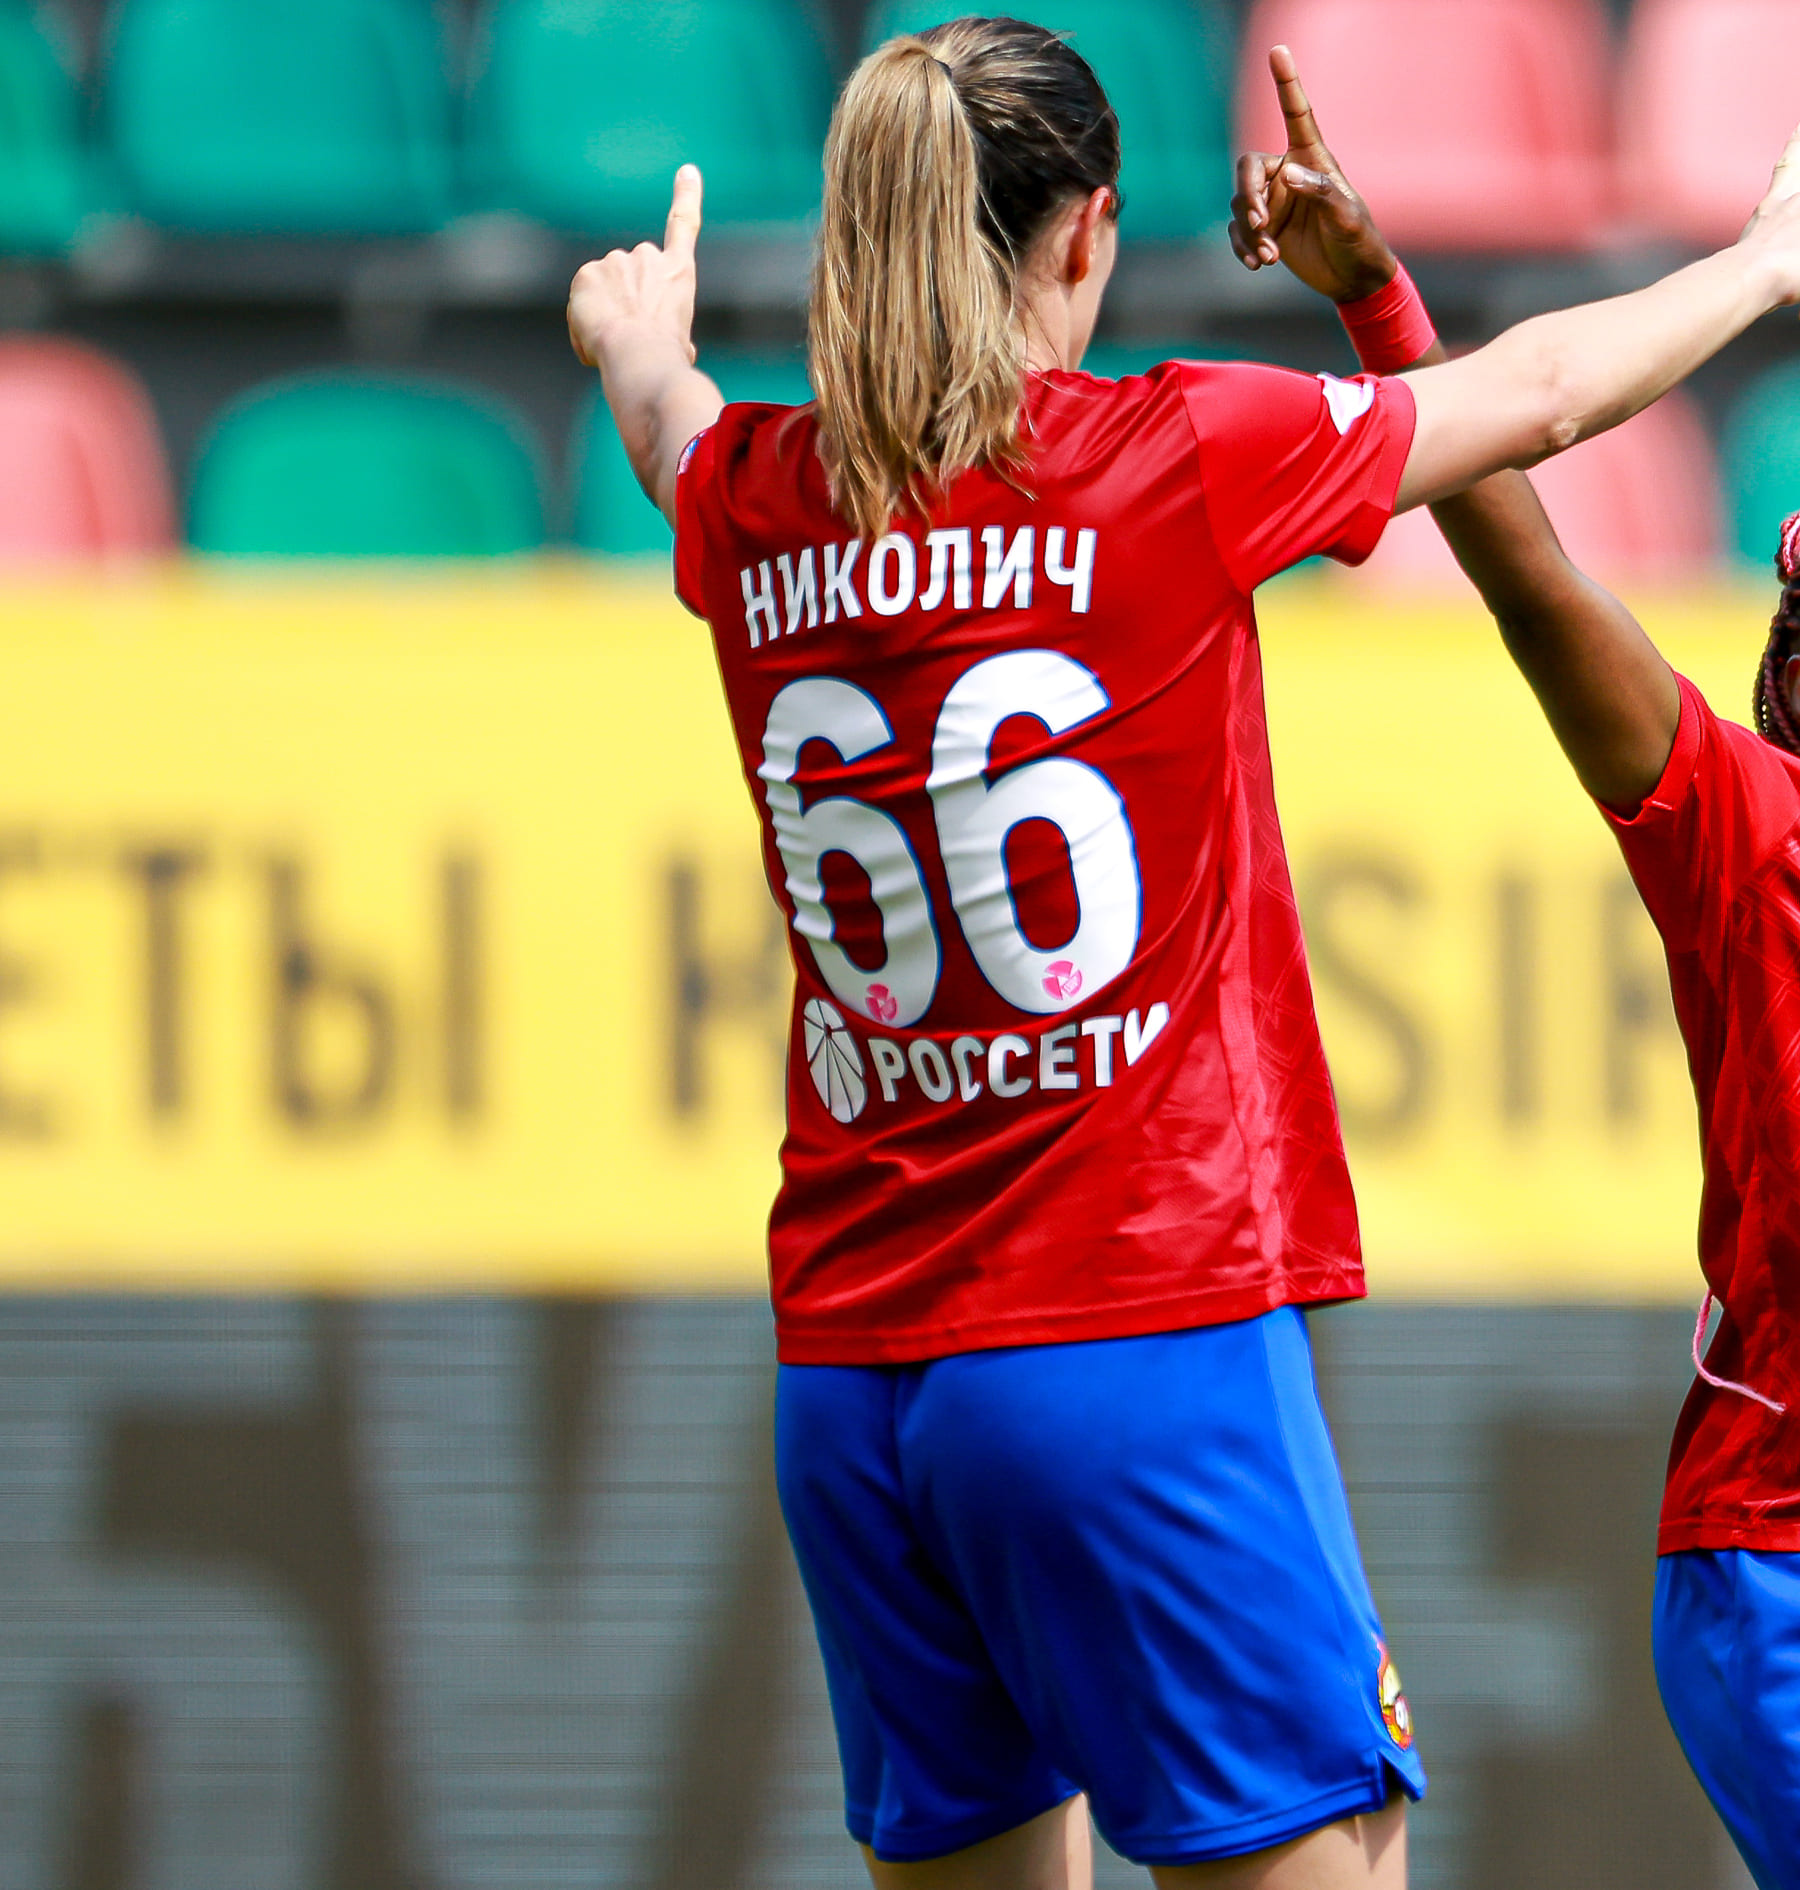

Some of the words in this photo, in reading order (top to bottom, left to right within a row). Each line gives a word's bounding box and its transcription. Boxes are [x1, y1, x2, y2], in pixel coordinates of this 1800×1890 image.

[738, 525, 1098, 649] НИКОЛИЧ
[756, 648, 1143, 1029] 66
[867, 1001, 1171, 1103] РОССЕТИ
